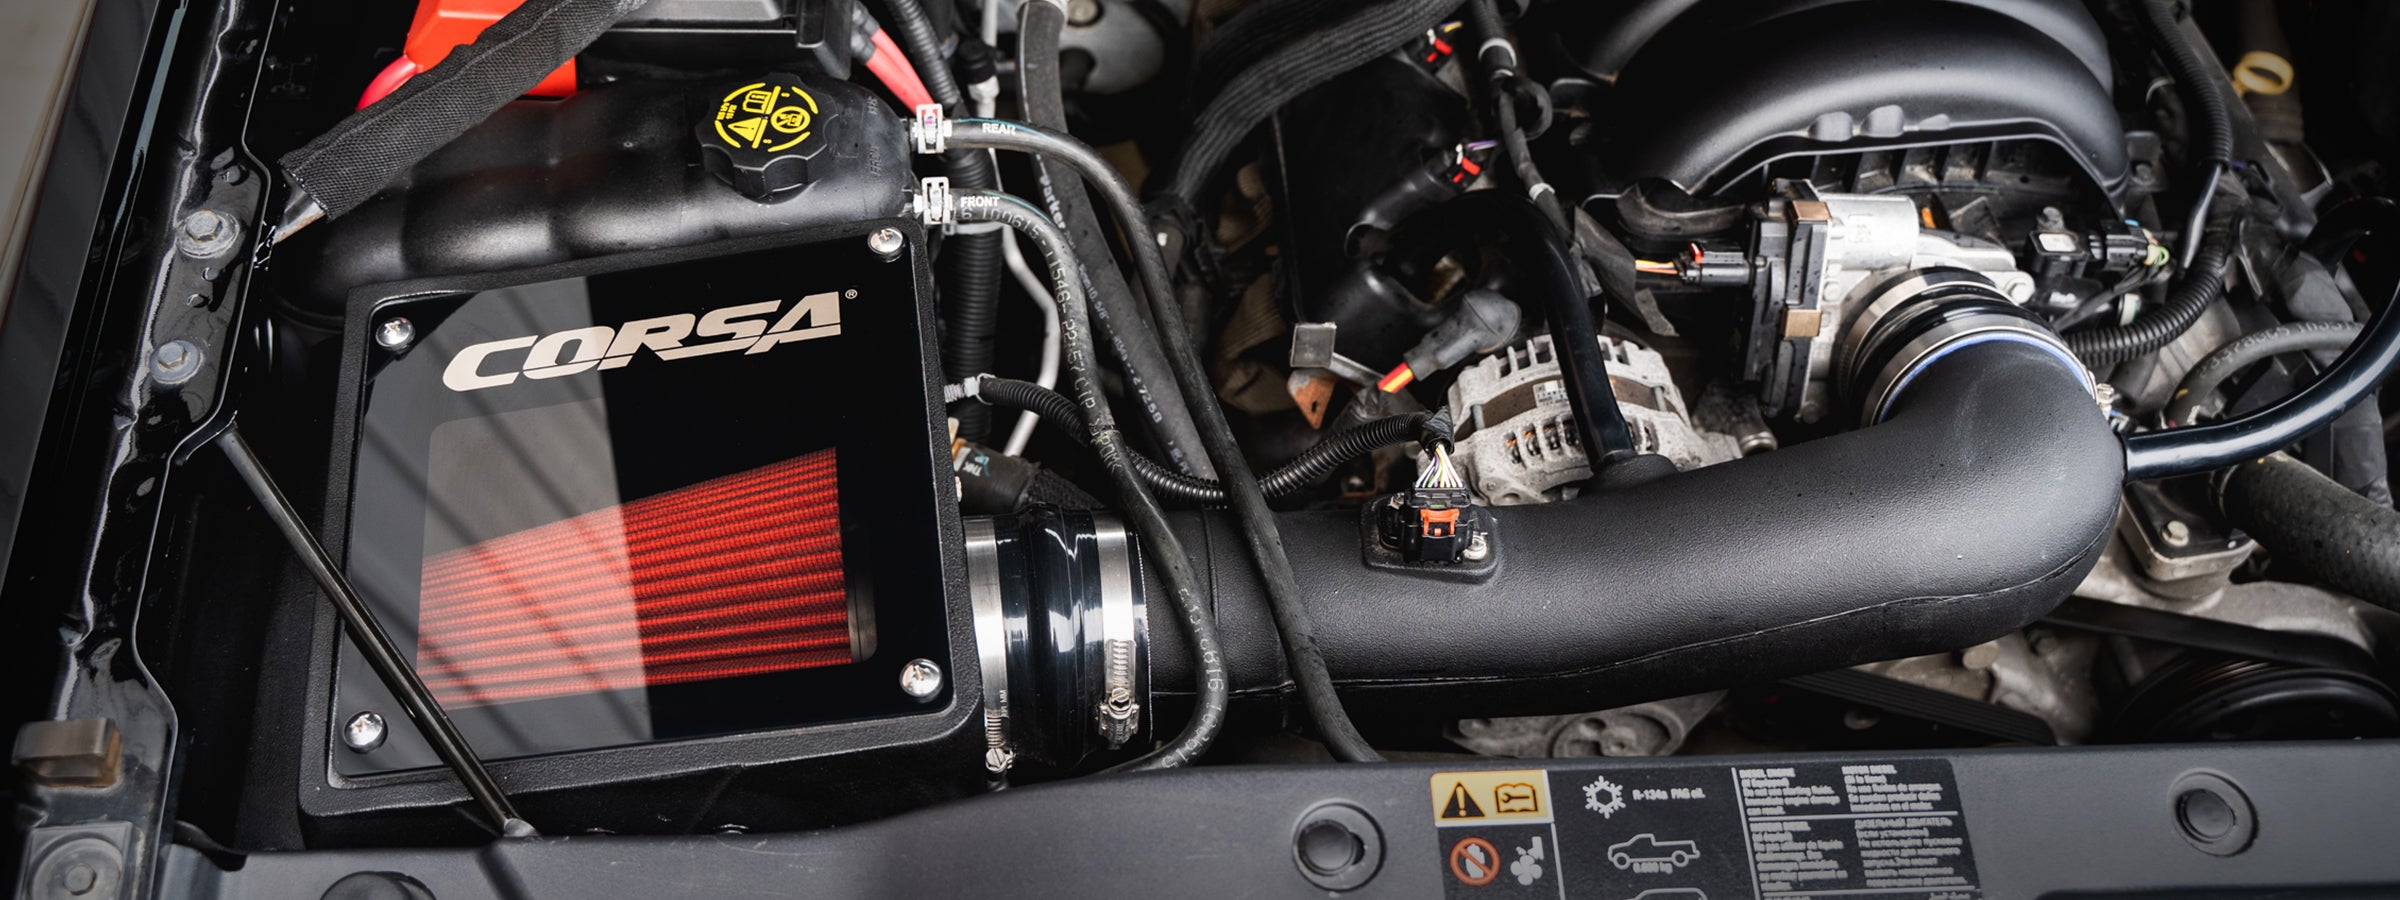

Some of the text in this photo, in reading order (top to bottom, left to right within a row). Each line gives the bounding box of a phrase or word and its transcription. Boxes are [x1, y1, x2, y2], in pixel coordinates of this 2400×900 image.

[982, 123, 1017, 135] REAR
[960, 196, 1000, 208] FRONT
[442, 291, 842, 392] CORSA
